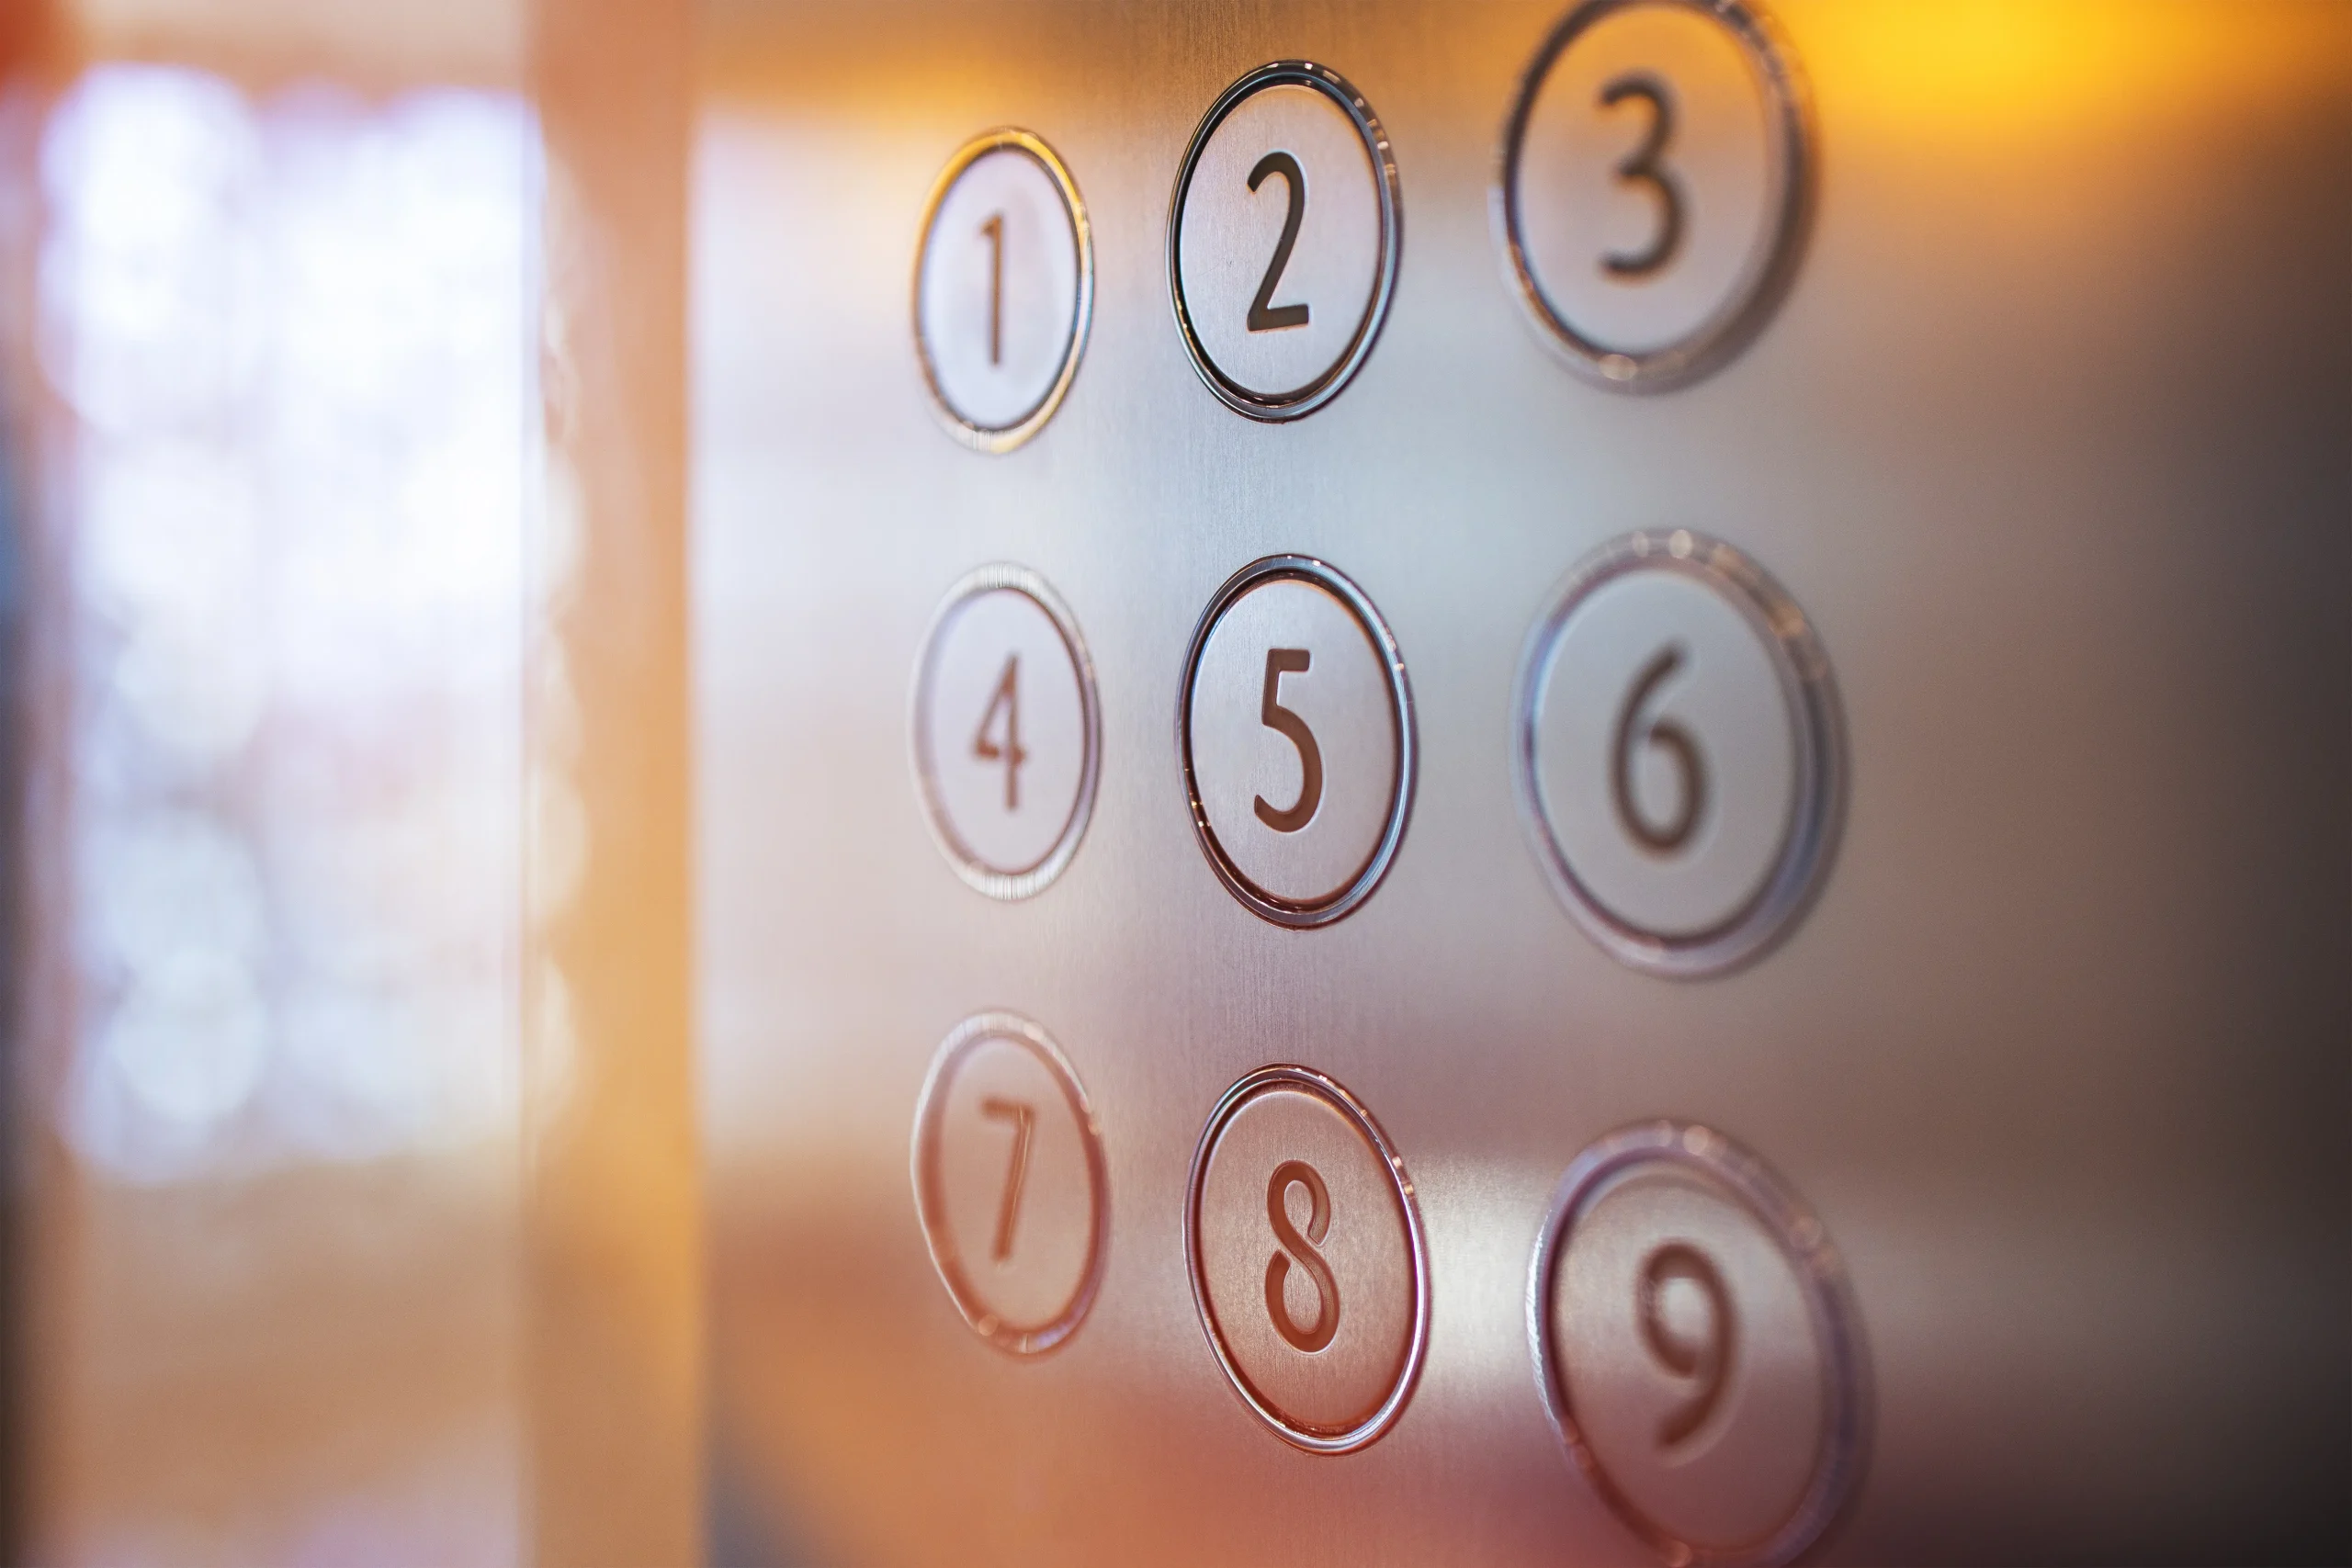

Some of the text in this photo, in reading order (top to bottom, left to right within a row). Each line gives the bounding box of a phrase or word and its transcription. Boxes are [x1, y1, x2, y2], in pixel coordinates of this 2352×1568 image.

[1247, 152, 1309, 332] 2
[1599, 77, 1688, 280] 3
[979, 214, 1004, 366] 1
[973, 654, 1028, 811] 4
[1254, 648, 1323, 833] 5
[1608, 646, 1709, 856] 6
[981, 1095, 1035, 1264] 7
[1265, 1159, 1340, 1354] 8
[1638, 1242, 1738, 1450] 9
